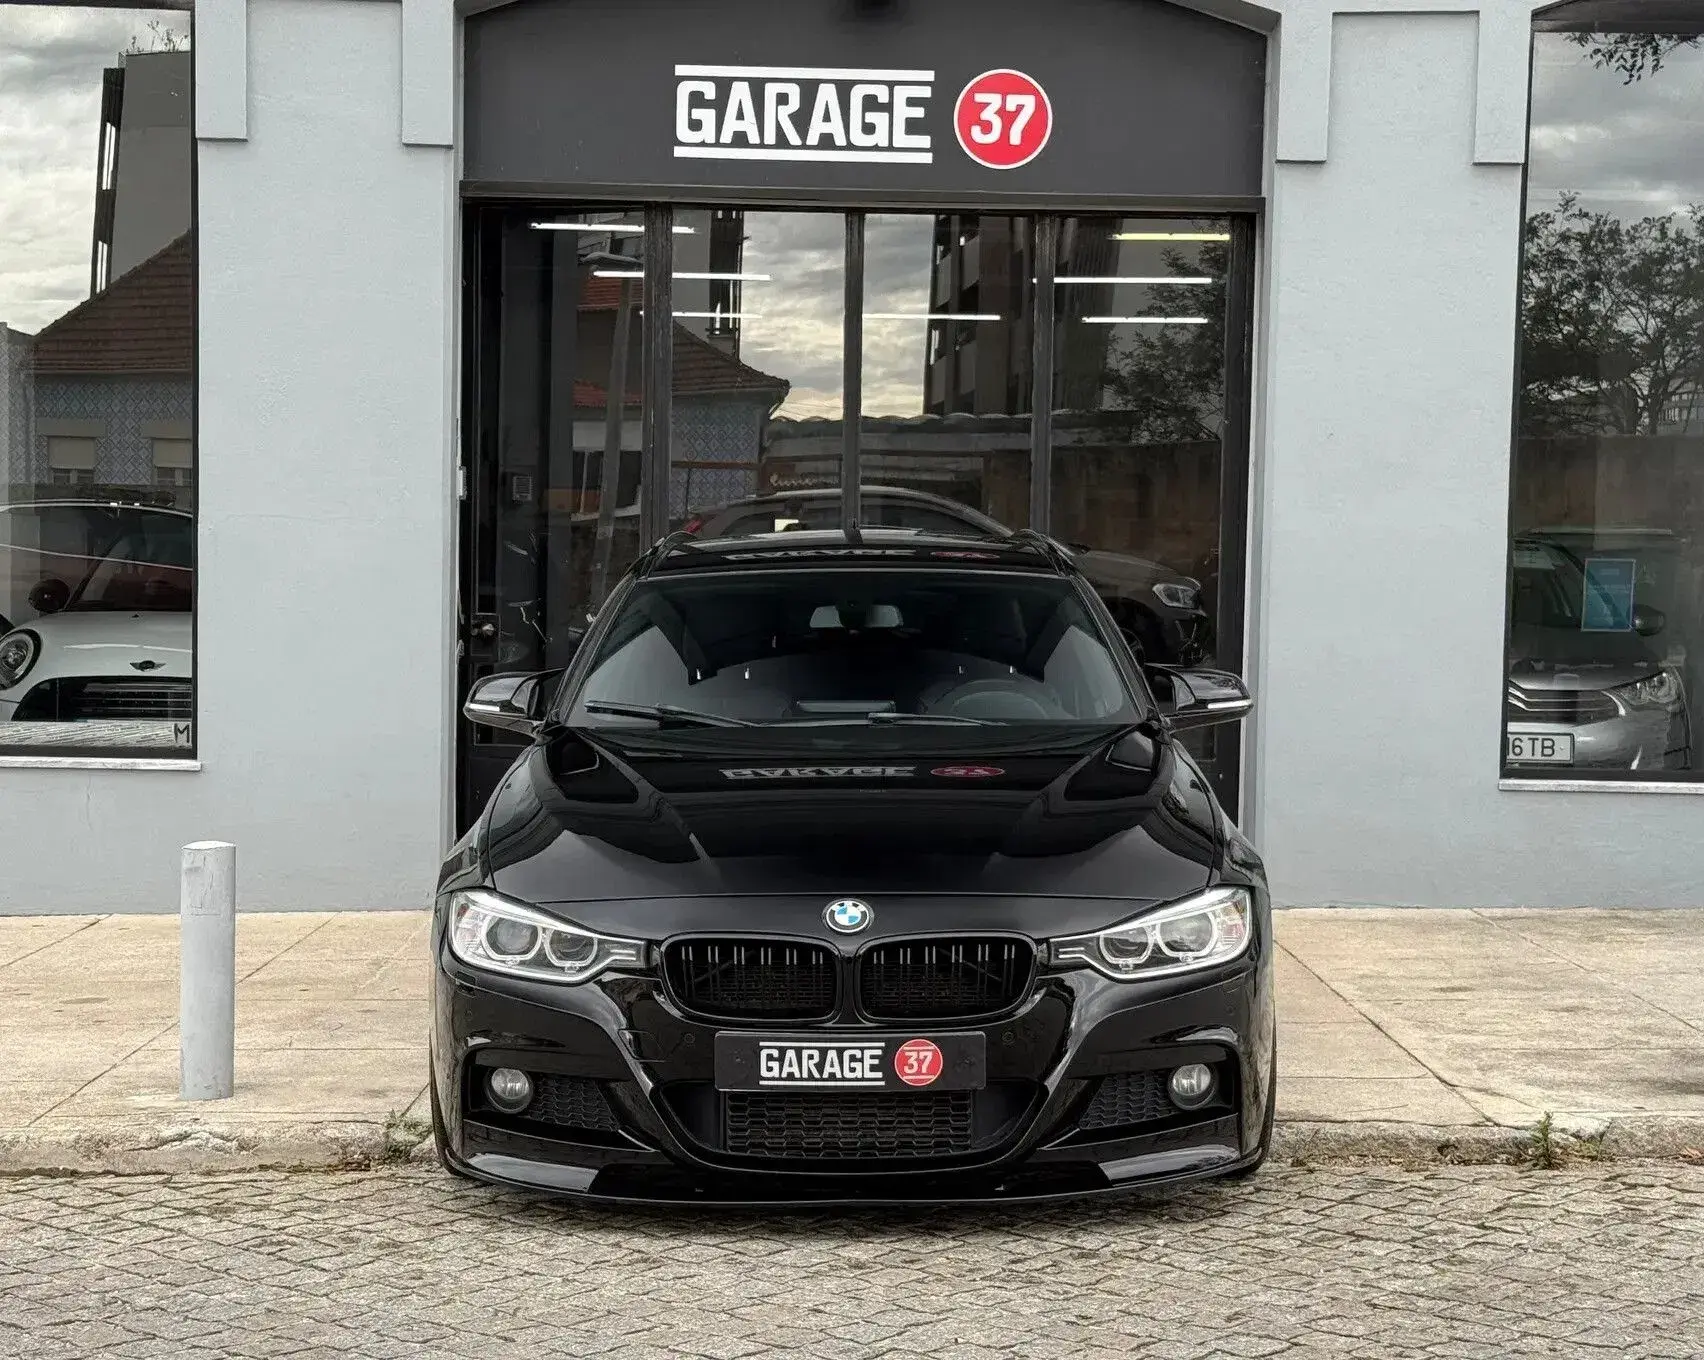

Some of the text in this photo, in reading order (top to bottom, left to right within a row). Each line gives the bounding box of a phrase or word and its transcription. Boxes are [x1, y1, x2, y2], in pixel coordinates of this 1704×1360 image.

[675, 79, 1036, 149] GARAGE 37
[759, 1048, 934, 1079] GARAGE 37
